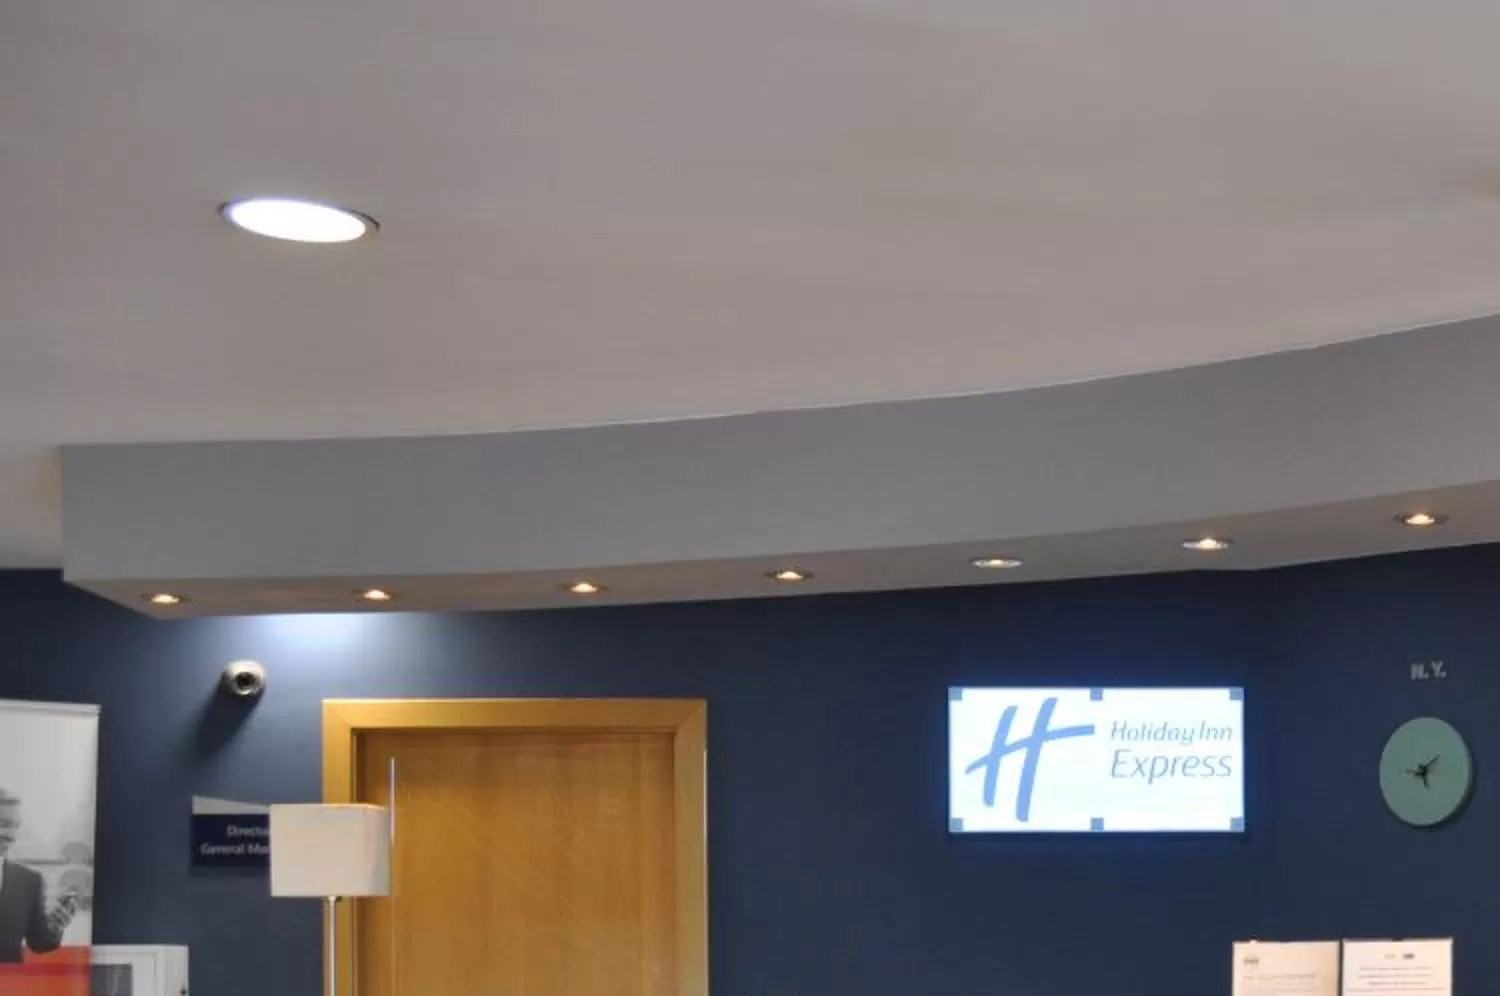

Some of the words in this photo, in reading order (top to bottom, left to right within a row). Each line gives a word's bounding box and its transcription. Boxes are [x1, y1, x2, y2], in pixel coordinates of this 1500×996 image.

[1410, 661, 1448, 680] N.Y.
[1109, 719, 1195, 746] Holiday
[1198, 721, 1234, 742] Inn
[1110, 748, 1234, 784] Express
[227, 824, 270, 837] Directo
